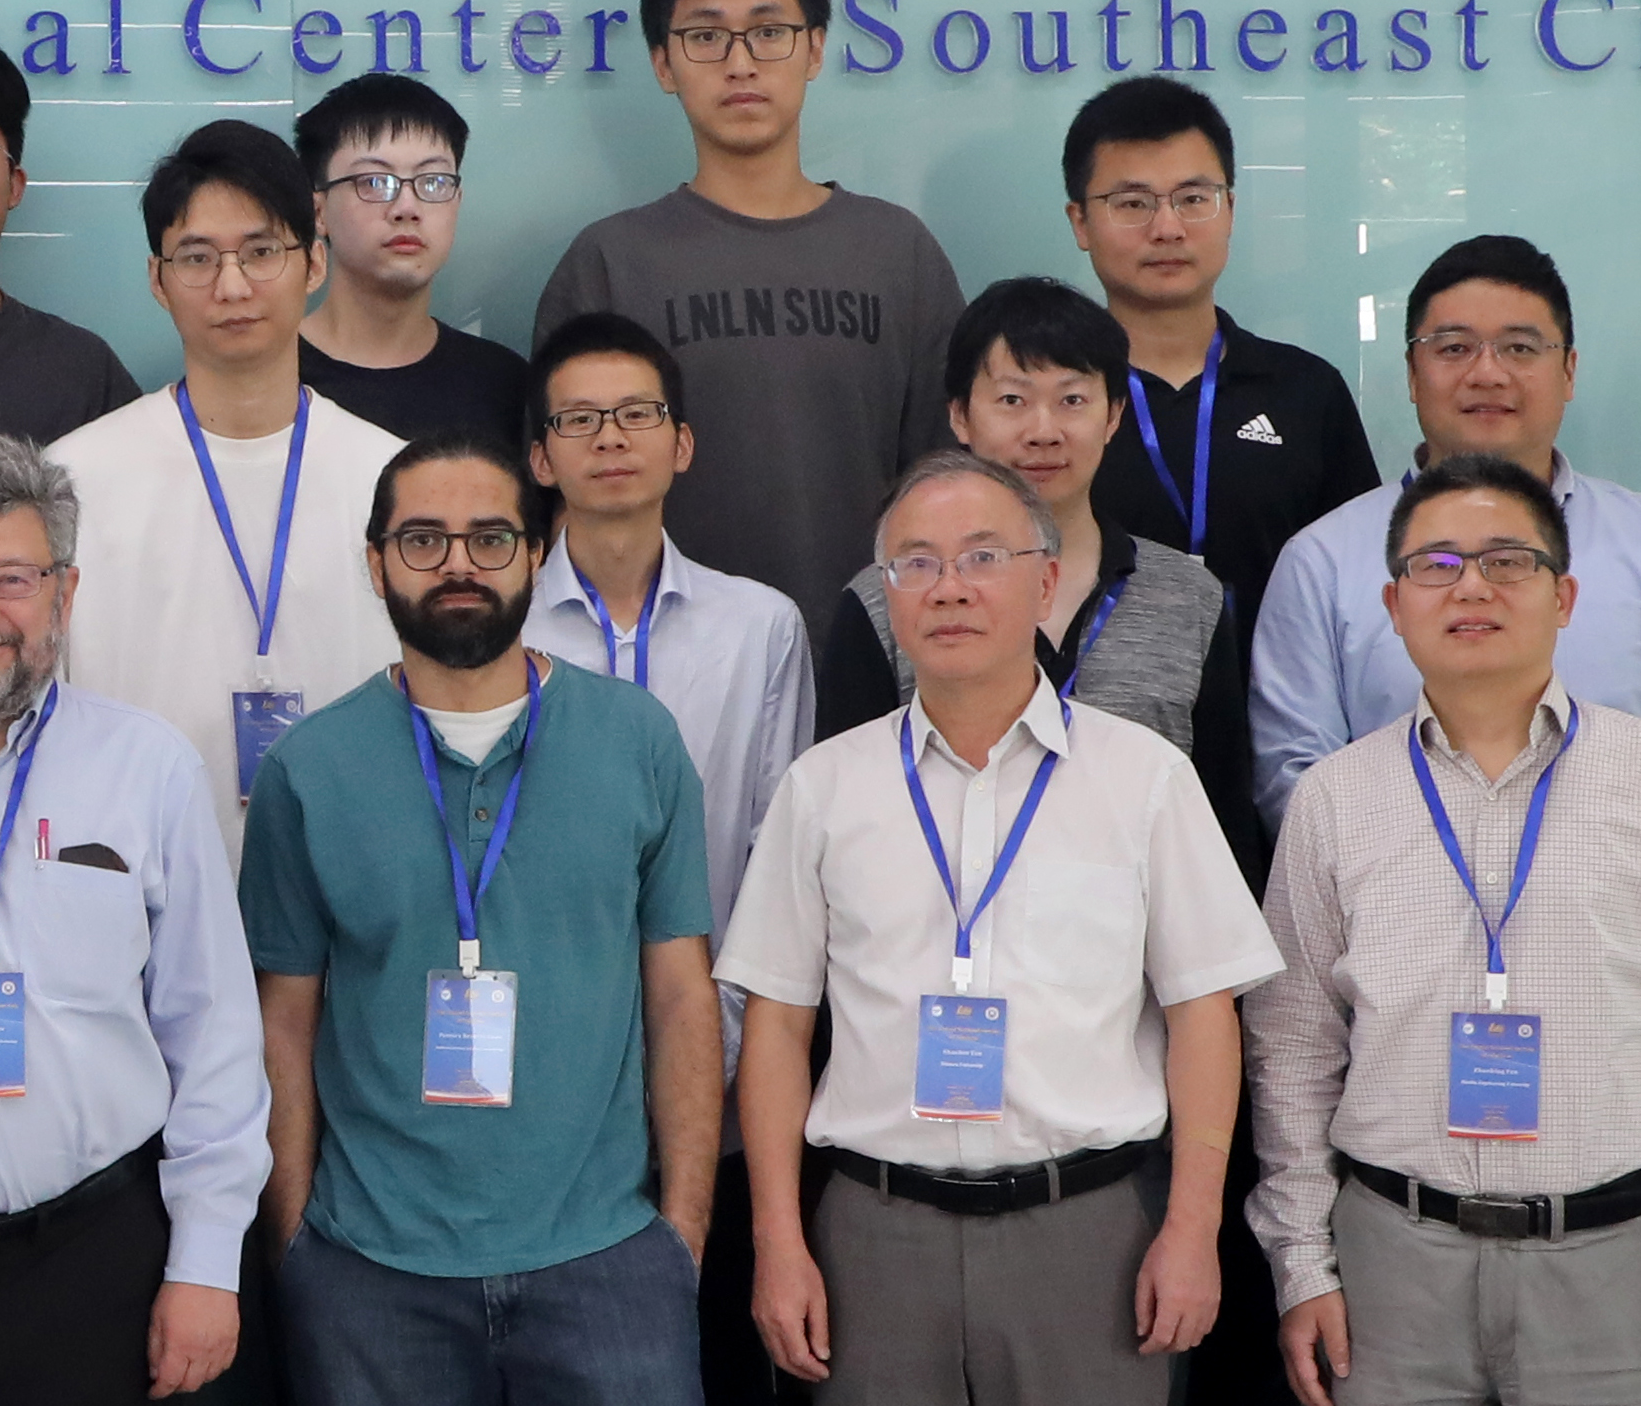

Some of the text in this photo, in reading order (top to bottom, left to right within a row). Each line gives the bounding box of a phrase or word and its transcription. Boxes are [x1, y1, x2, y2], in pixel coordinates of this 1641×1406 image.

[664, 287, 882, 347] LNLN SUSU
[1236, 429, 1284, 445] adidas
